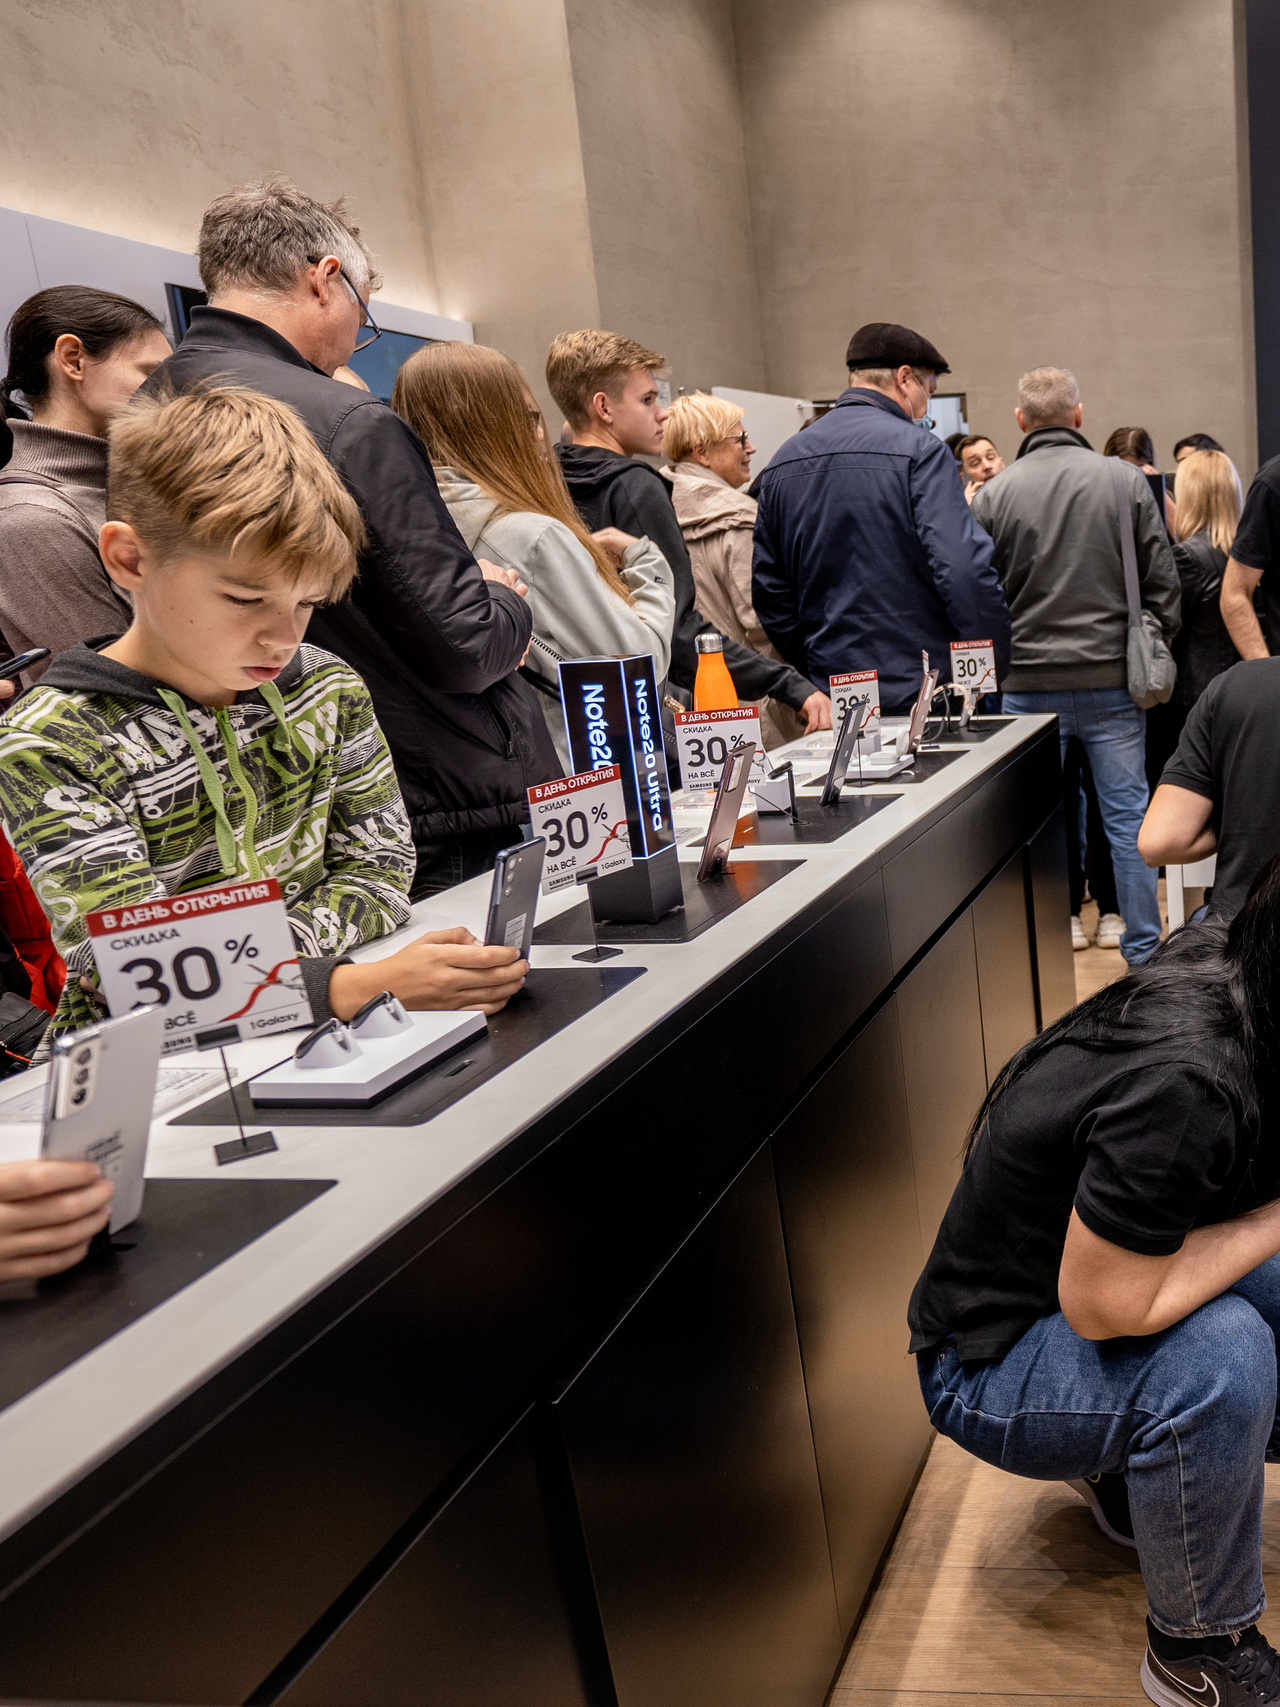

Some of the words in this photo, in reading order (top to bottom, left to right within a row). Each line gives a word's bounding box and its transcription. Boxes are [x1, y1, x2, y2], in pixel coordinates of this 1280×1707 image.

[688, 713, 709, 722] ДЕНЬ
[710, 709, 753, 719] ОТКРЫТИЯ
[683, 725, 713, 734] СКИДКА
[634, 679, 656, 769] Note20
[647, 771, 663, 832] Ultra
[701, 769, 715, 777] ВСЁ
[535, 788, 542, 798] В
[543, 782, 567, 797] ДЕНЬ
[568, 768, 615, 788] ОТКРЫТИЯ
[538, 798, 572, 814] СКИДКА
[547, 861, 560, 874] НА
[561, 856, 577, 870] ВСЁ
[102, 914, 118, 929] В
[120, 905, 169, 928] ДЕНЬ
[172, 884, 270, 915] ОТКРЫТИЯ
[110, 928, 181, 950] СКИДКА
[164, 1010, 198, 1030] ВСЁ
